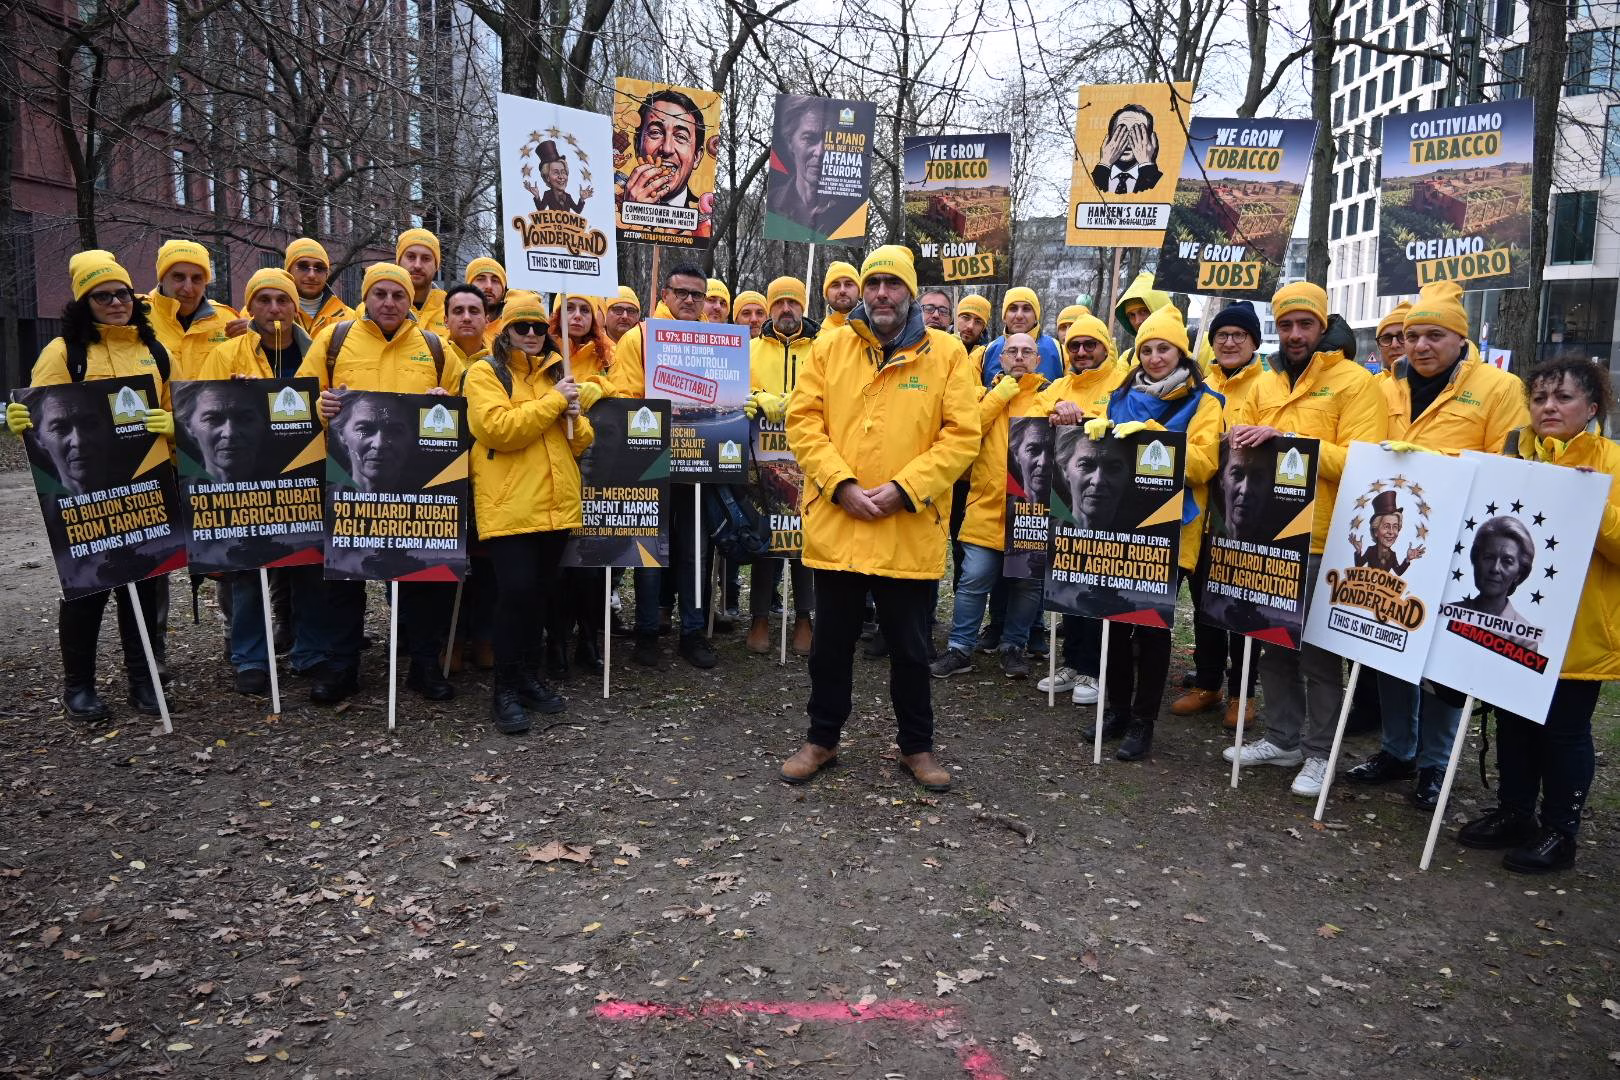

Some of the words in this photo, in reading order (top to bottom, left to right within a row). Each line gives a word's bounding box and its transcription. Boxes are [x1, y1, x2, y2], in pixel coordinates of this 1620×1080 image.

[1410, 113, 1501, 139] COLTIVIAMO
[825, 131, 833, 143] IL
[836, 132, 865, 146] PIANO
[1215, 128, 1237, 145] WE
[1240, 129, 1283, 147] GROW
[930, 145, 946, 159] WE
[951, 144, 985, 158] GROW
[1413, 134, 1497, 162] TABACCO
[823, 151, 862, 166] AFFAMA
[1208, 149, 1280, 170] TOBACCO
[822, 165, 861, 178] L'EUROPA
[927, 161, 987, 179] TOBACCO
[531, 213, 585, 229] WELCOME
[626, 205, 669, 217] COMMISSIONER
[672, 210, 694, 220] HANSEN
[1088, 207, 1131, 218] HANSEN'S
[1135, 207, 1157, 218] GAZE
[513, 218, 606, 256] VONDERLAND
[921, 244, 938, 258] WE
[944, 243, 977, 256] GROW
[1179, 242, 1199, 259] WE
[1204, 243, 1245, 261] GROW
[1406, 236, 1483, 260] CREIAMO
[532, 256, 548, 267] THIS
[550, 258, 557, 268] IS
[559, 259, 571, 269] NOT
[573, 260, 596, 271] EUROPE
[948, 256, 990, 278] JOBS
[1422, 252, 1506, 283] LAVORO
[1202, 264, 1256, 286] JOBS
[658, 332, 664, 340] IL
[666, 332, 680, 342] 97%
[682, 334, 692, 342] DEI
[695, 334, 708, 343] CIBI
[710, 335, 730, 345] EXTRA
[731, 336, 739, 346] UE
[663, 344, 681, 353] ENTRA
[692, 346, 714, 355] EUROPA
[657, 354, 683, 365] SENZA
[686, 356, 727, 369] CONTROLLI
[658, 371, 713, 397] INACCETTABILE
[705, 370, 739, 380] ADEGUATI
[271, 422, 312, 430] COLDIRETTI
[681, 439, 705, 448] SALUTE
[189, 485, 196, 494] IL
[198, 482, 234, 493] BILANCIO
[237, 481, 259, 491] DELLA
[260, 480, 276, 489] VON
[278, 479, 293, 488] DER
[295, 478, 319, 487] LEYEN:
[1135, 477, 1173, 486] COLDIRETTI
[1274, 486, 1305, 496] COLDIRETTI
[58, 497, 74, 508] THE
[75, 494, 90, 506] VON
[92, 491, 107, 502] DER
[108, 486, 130, 499] LEYEN
[131, 480, 160, 493] BUDGET:
[190, 495, 208, 510] 90
[212, 491, 271, 509] MILIARDI
[276, 488, 320, 504] RUBATI
[334, 492, 341, 500] IL
[343, 492, 377, 501] BILANCIO
[380, 493, 400, 502] DELLA
[403, 494, 417, 503] VON
[420, 495, 433, 503] DER
[435, 495, 458, 504] LEYEN:
[61, 508, 77, 524] 90
[80, 499, 123, 520] BILLION
[125, 490, 164, 510] STOLEN
[193, 510, 225, 528] AGLI
[231, 504, 322, 526] AGRICOLTORI
[334, 503, 350, 518] 90
[355, 503, 410, 519] MILIARDI
[416, 505, 457, 520] RUBATI
[623, 502, 658, 514] HARMS
[1014, 502, 1030, 514] THE
[66, 519, 107, 544] FROM
[109, 506, 167, 534] FARMERS
[333, 519, 366, 536] AGLI
[369, 520, 457, 537] AGRICOLTORI
[606, 515, 637, 526] HEALTH
[640, 515, 658, 526] AND
[1014, 515, 1048, 529] AGREEM
[193, 529, 212, 541] PER
[215, 526, 248, 539] BOMBE
[251, 526, 257, 536] E
[260, 524, 287, 535] CARRI
[290, 521, 323, 533] ARMATI
[614, 528, 658, 536] AGRICULTURE
[1056, 526, 1061, 535] IL
[1063, 528, 1093, 538] BILANCIO
[1095, 530, 1114, 541] DELLA
[1117, 533, 1130, 542] VON
[1132, 535, 1145, 544] DER
[1148, 536, 1170, 547] LEYEN:
[70, 544, 89, 558] FOR
[91, 535, 123, 553] BOMBS
[125, 531, 143, 545] AND
[144, 524, 171, 539] TANKS
[332, 537, 351, 548] PER
[353, 537, 385, 548] BOMBE
[388, 538, 393, 548] E
[396, 538, 422, 548] CARRI
[425, 539, 457, 550] ARMATI
[1014, 541, 1044, 550] SACRIFICES
[1055, 537, 1068, 552] 90
[1073, 539, 1123, 558] MILIARDI
[1128, 545, 1170, 563] RUBATI
[1218, 538, 1240, 550] BILANCIO
[1241, 541, 1255, 552] DELLA
[1258, 544, 1268, 555] VON
[1269, 547, 1280, 557] DER
[1282, 550, 1300, 561] LEYEN:
[1053, 553, 1080, 571] AGLI
[1084, 556, 1169, 582] AGRICOLTORI
[1211, 547, 1221, 562] 90
[1224, 550, 1262, 571] MILIARDI
[1266, 558, 1300, 579] RUBATI
[1052, 570, 1067, 581] PER
[1070, 572, 1098, 585] BOMBE
[1108, 577, 1132, 589] CARRI
[1136, 580, 1167, 594] ARMATI
[1209, 564, 1229, 583] AGLI
[1232, 568, 1298, 599] AGRICOLTORI
[1346, 570, 1404, 594] WELCOME
[1207, 581, 1218, 593] PER
[1221, 584, 1242, 599] BOMBE
[1249, 591, 1268, 605] CARRI
[1270, 596, 1296, 612] ARMATI
[1328, 571, 1423, 628] VONDERLAND
[1334, 613, 1350, 628] THIS
[1351, 620, 1358, 631] IS
[1360, 622, 1374, 636] NOT
[1375, 627, 1403, 646] EUROPE
[1477, 614, 1513, 632] TURN
[1516, 624, 1543, 639] OFF
[1451, 621, 1545, 669] DEMOCRACY
